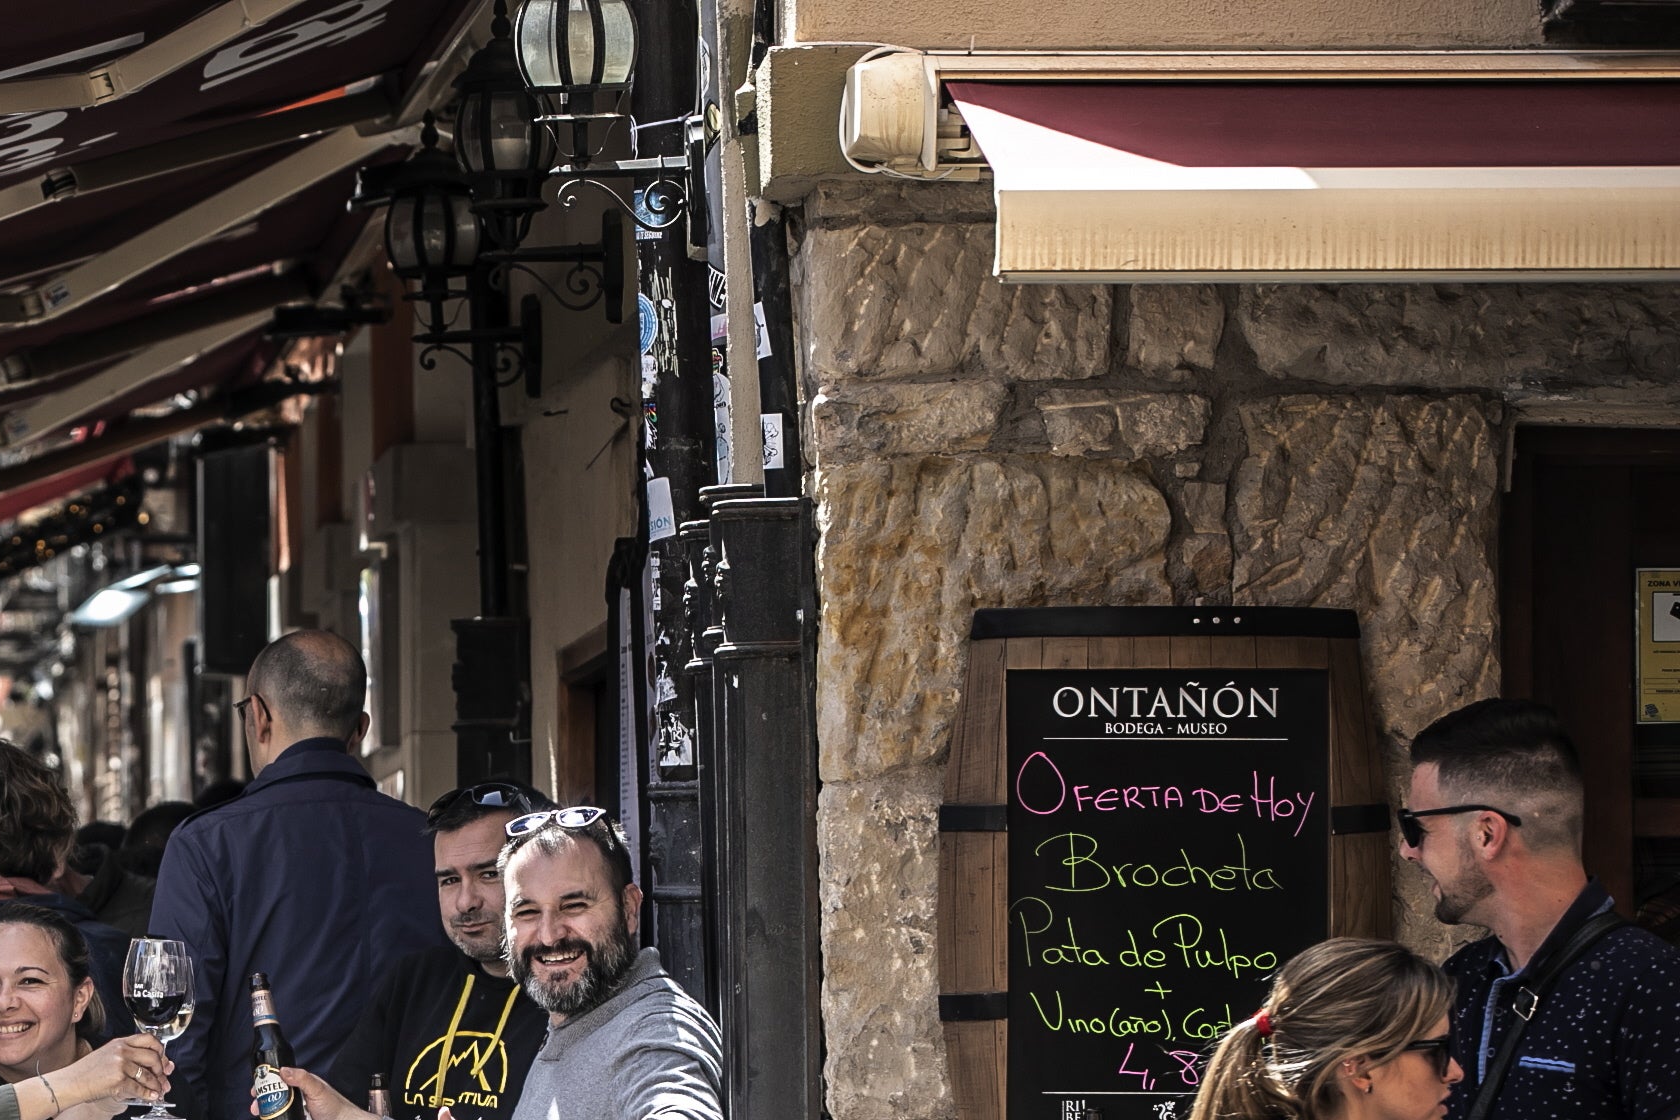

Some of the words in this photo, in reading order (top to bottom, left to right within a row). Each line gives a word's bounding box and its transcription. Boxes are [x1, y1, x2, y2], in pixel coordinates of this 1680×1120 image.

[1052, 681, 1279, 718] ONTAÑÓN
[1105, 722, 1164, 735] BODEGA
[1177, 722, 1228, 735] MUSEO
[1035, 832, 1283, 892] Brocheta
[1008, 896, 1110, 967] Pata
[1120, 930, 1167, 968] de
[1152, 914, 1277, 979] Pulpo
[1118, 1042, 1200, 1091] 4,8
